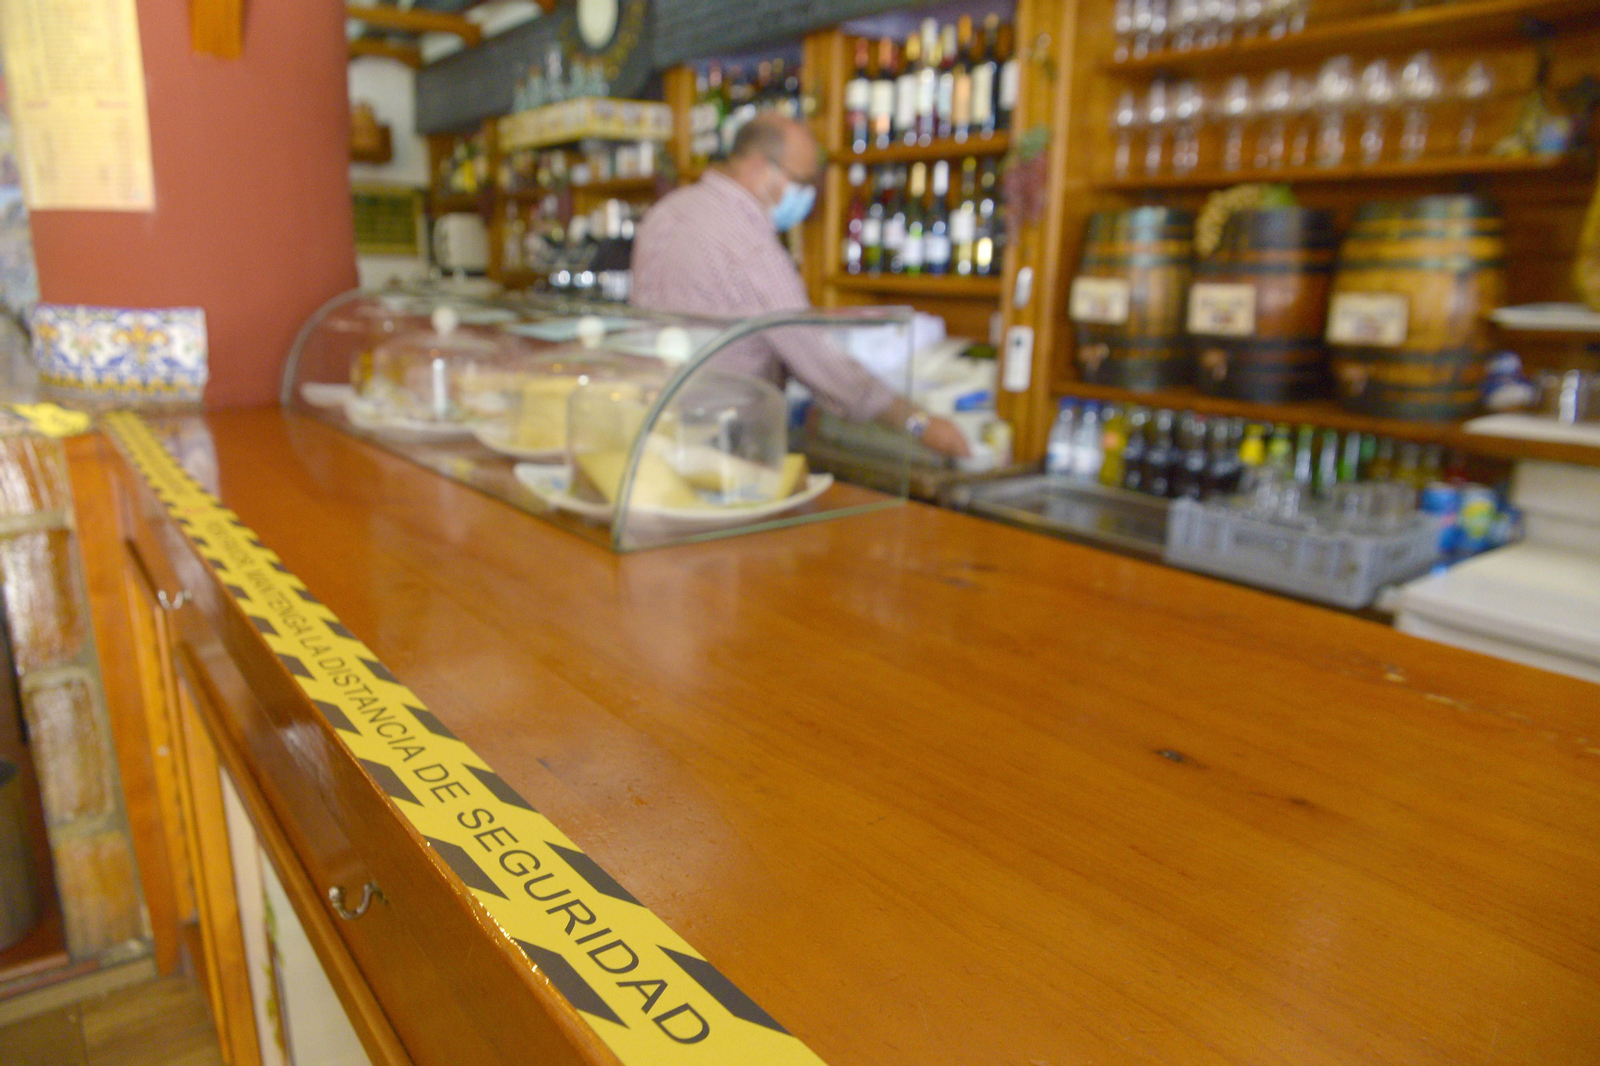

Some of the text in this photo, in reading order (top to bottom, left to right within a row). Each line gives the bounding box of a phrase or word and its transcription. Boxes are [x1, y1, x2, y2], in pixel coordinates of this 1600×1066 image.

[299, 636, 332, 658] LA
[318, 657, 424, 761] DISTANCIA
[413, 764, 470, 803] DE
[457, 808, 709, 1044] SEGURIDAD
